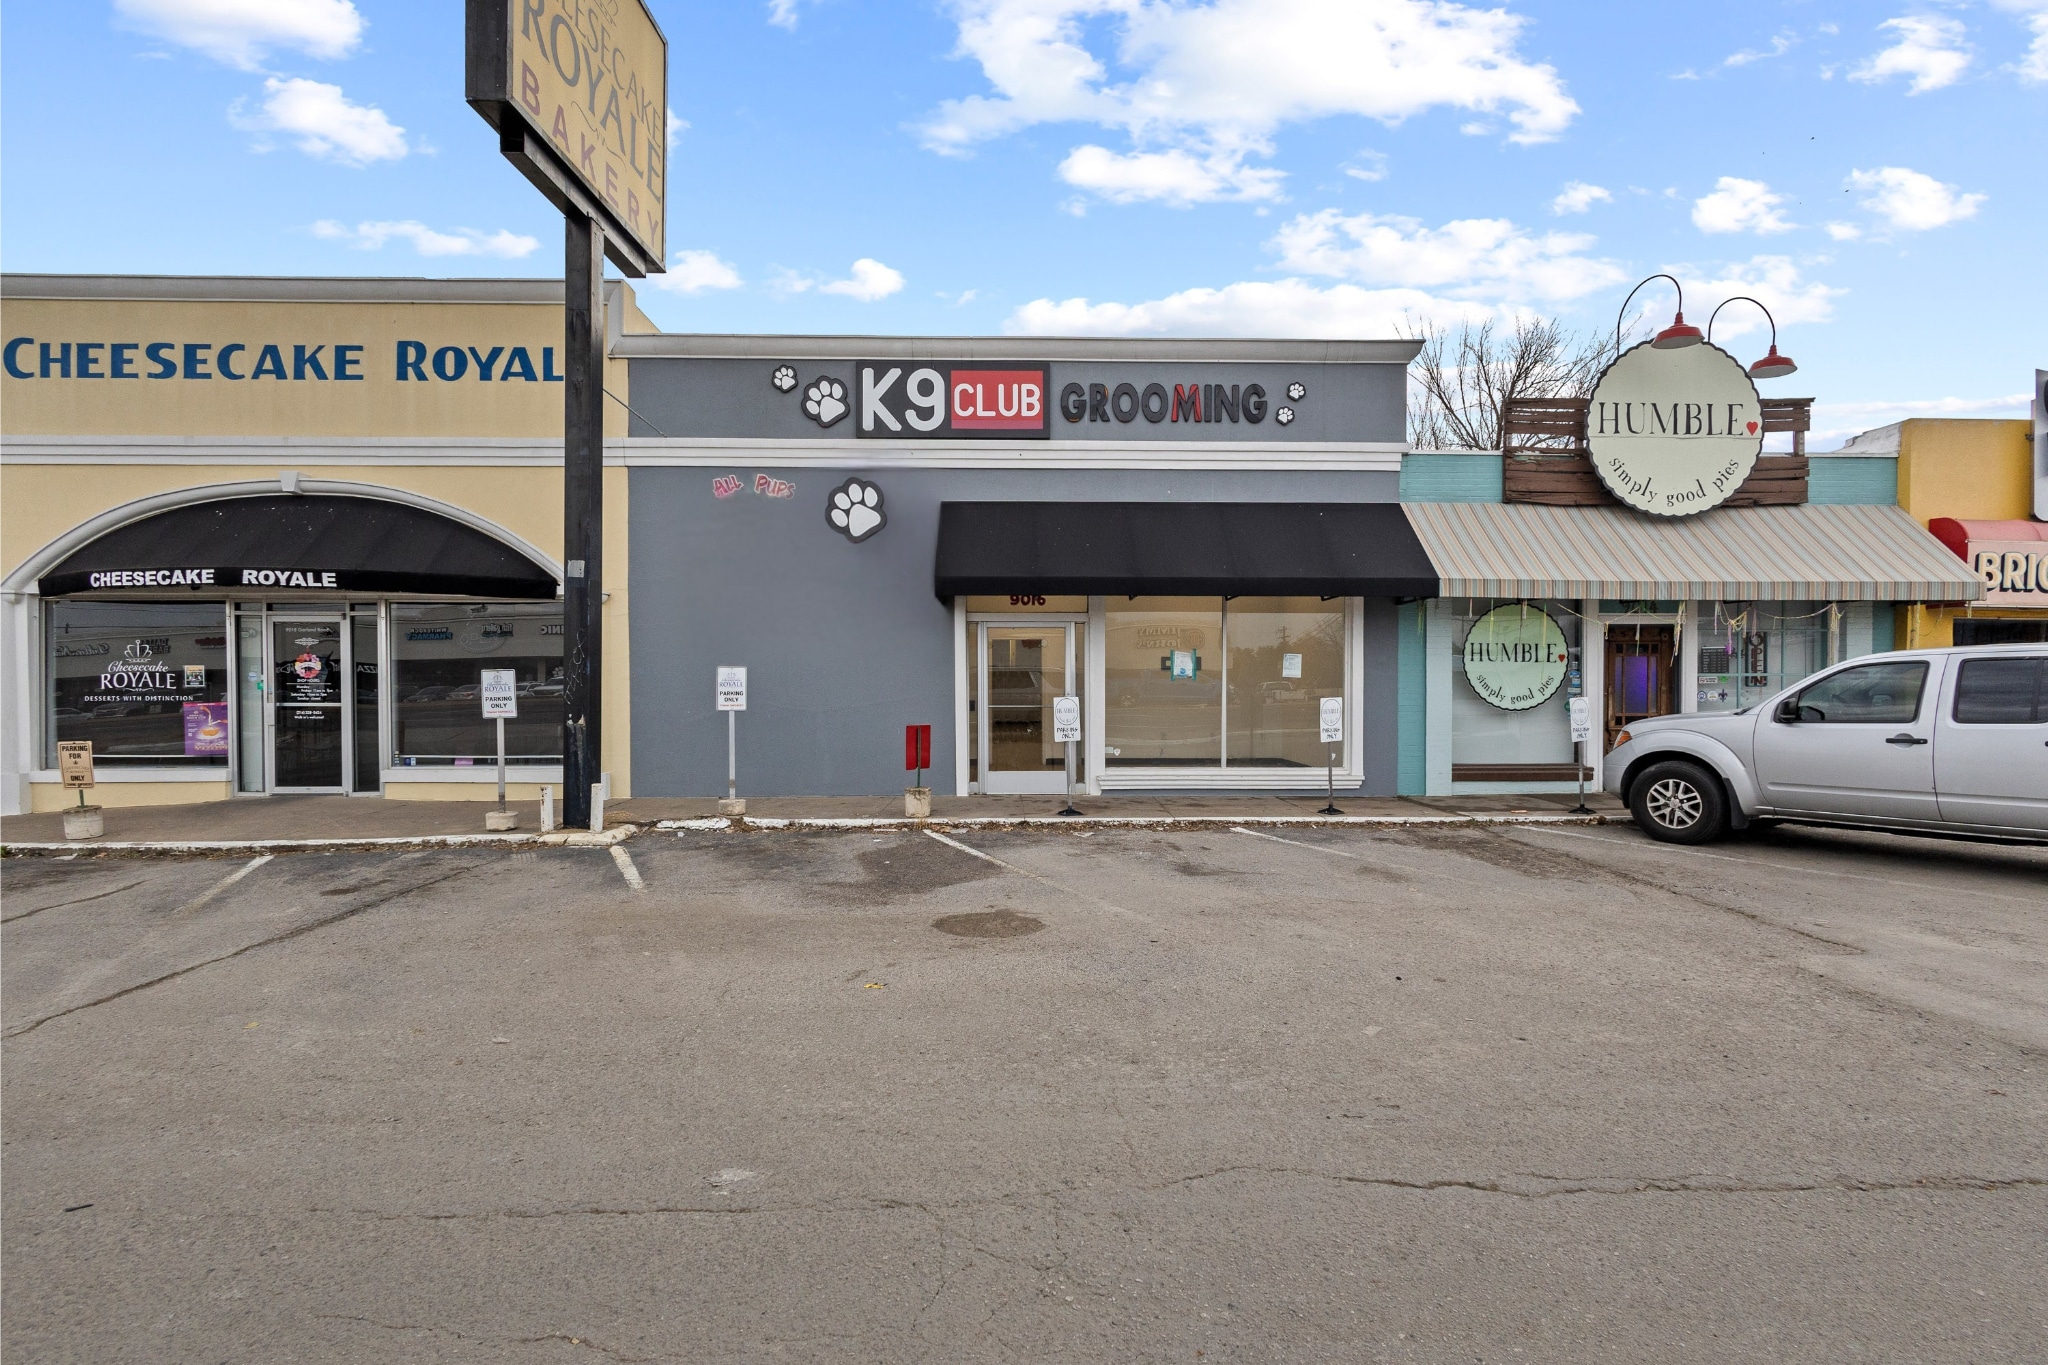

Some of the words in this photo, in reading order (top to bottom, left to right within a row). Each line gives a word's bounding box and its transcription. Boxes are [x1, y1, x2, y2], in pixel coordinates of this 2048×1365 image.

[556, 0, 661, 149] ESECAKE
[520, 0, 661, 204] ROYALE
[521, 59, 659, 249] BAKERY
[3, 337, 364, 380] CHEESECAKE
[396, 340, 565, 382] ROYAL
[861, 367, 946, 432] K9
[953, 382, 1042, 419] CLUB
[1061, 382, 1267, 424] GROOMING
[1598, 401, 1744, 436] HUMBLE
[712, 474, 744, 498] ALL
[754, 473, 796, 499] PUPS
[1608, 456, 1658, 503] simply
[1667, 479, 1707, 507] good
[1712, 458, 1741, 493] pies
[90, 568, 215, 588] CHEESECAKE
[241, 569, 338, 588] ROYALE
[1469, 641, 1557, 663] HUMBLE
[108, 660, 170, 673] Cheesecake
[100, 672, 177, 690] ROYALE
[484, 685, 512, 693] ROYALE
[1476, 673, 1507, 702] simply
[1510, 688, 1535, 704] good
[1537, 674, 1555, 697] pies
[84, 694, 121, 702] DESSERTS
[68, 752, 82, 760] FOR
